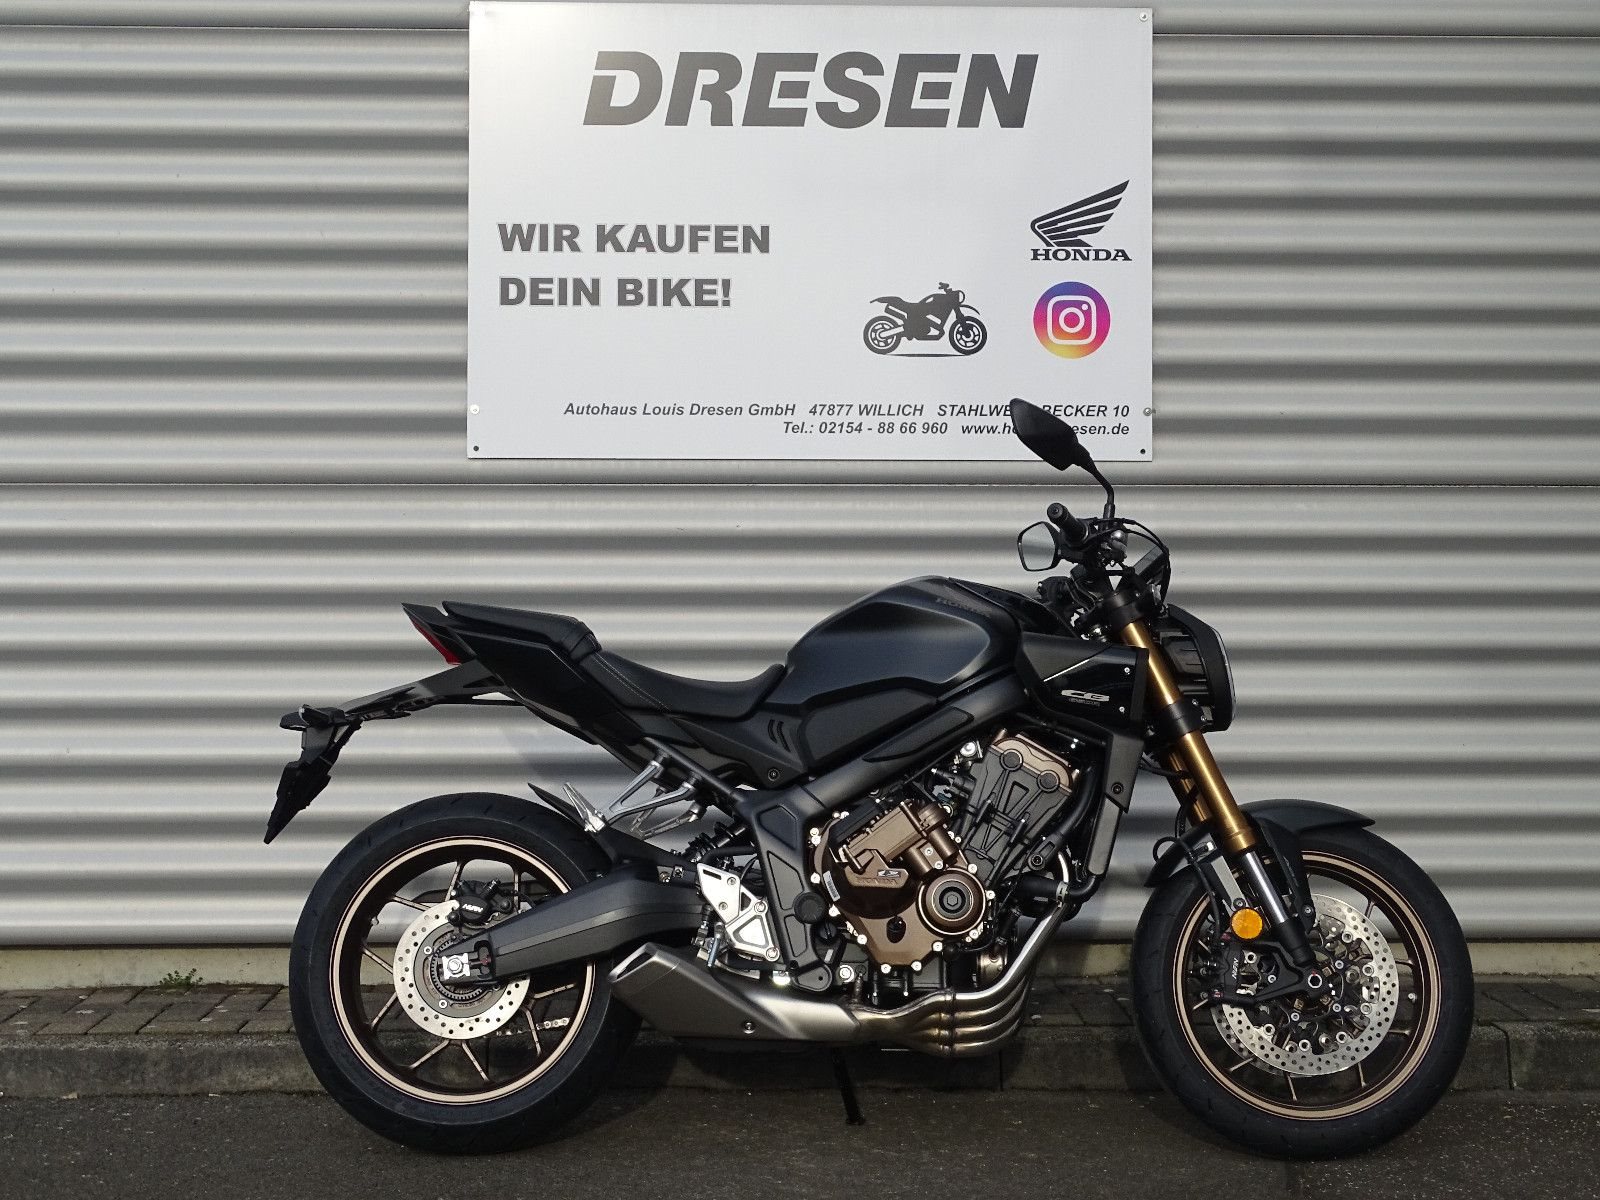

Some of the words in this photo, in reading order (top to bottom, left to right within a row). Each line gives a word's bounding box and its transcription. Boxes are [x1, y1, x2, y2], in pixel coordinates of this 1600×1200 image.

[583, 51, 1039, 129] DRESEN
[497, 223, 582, 253] WIR
[596, 224, 770, 254] KAUFEN
[1030, 248, 1132, 262] HONDA
[499, 277, 600, 306] DEIN
[617, 278, 731, 307] BIKE!
[563, 402, 638, 416] Autohaus
[642, 403, 685, 416] Louis
[689, 403, 743, 416] Dresen
[748, 403, 796, 416] GmbH
[808, 403, 854, 416] 47877
[858, 403, 925, 417] WILLICH
[1113, 404, 1130, 417] 10
[783, 421, 814, 434] Tel.:
[818, 421, 863, 434] 02154
[877, 421, 895, 434] 88
[899, 421, 917, 434] 66
[921, 421, 948, 435] 960
